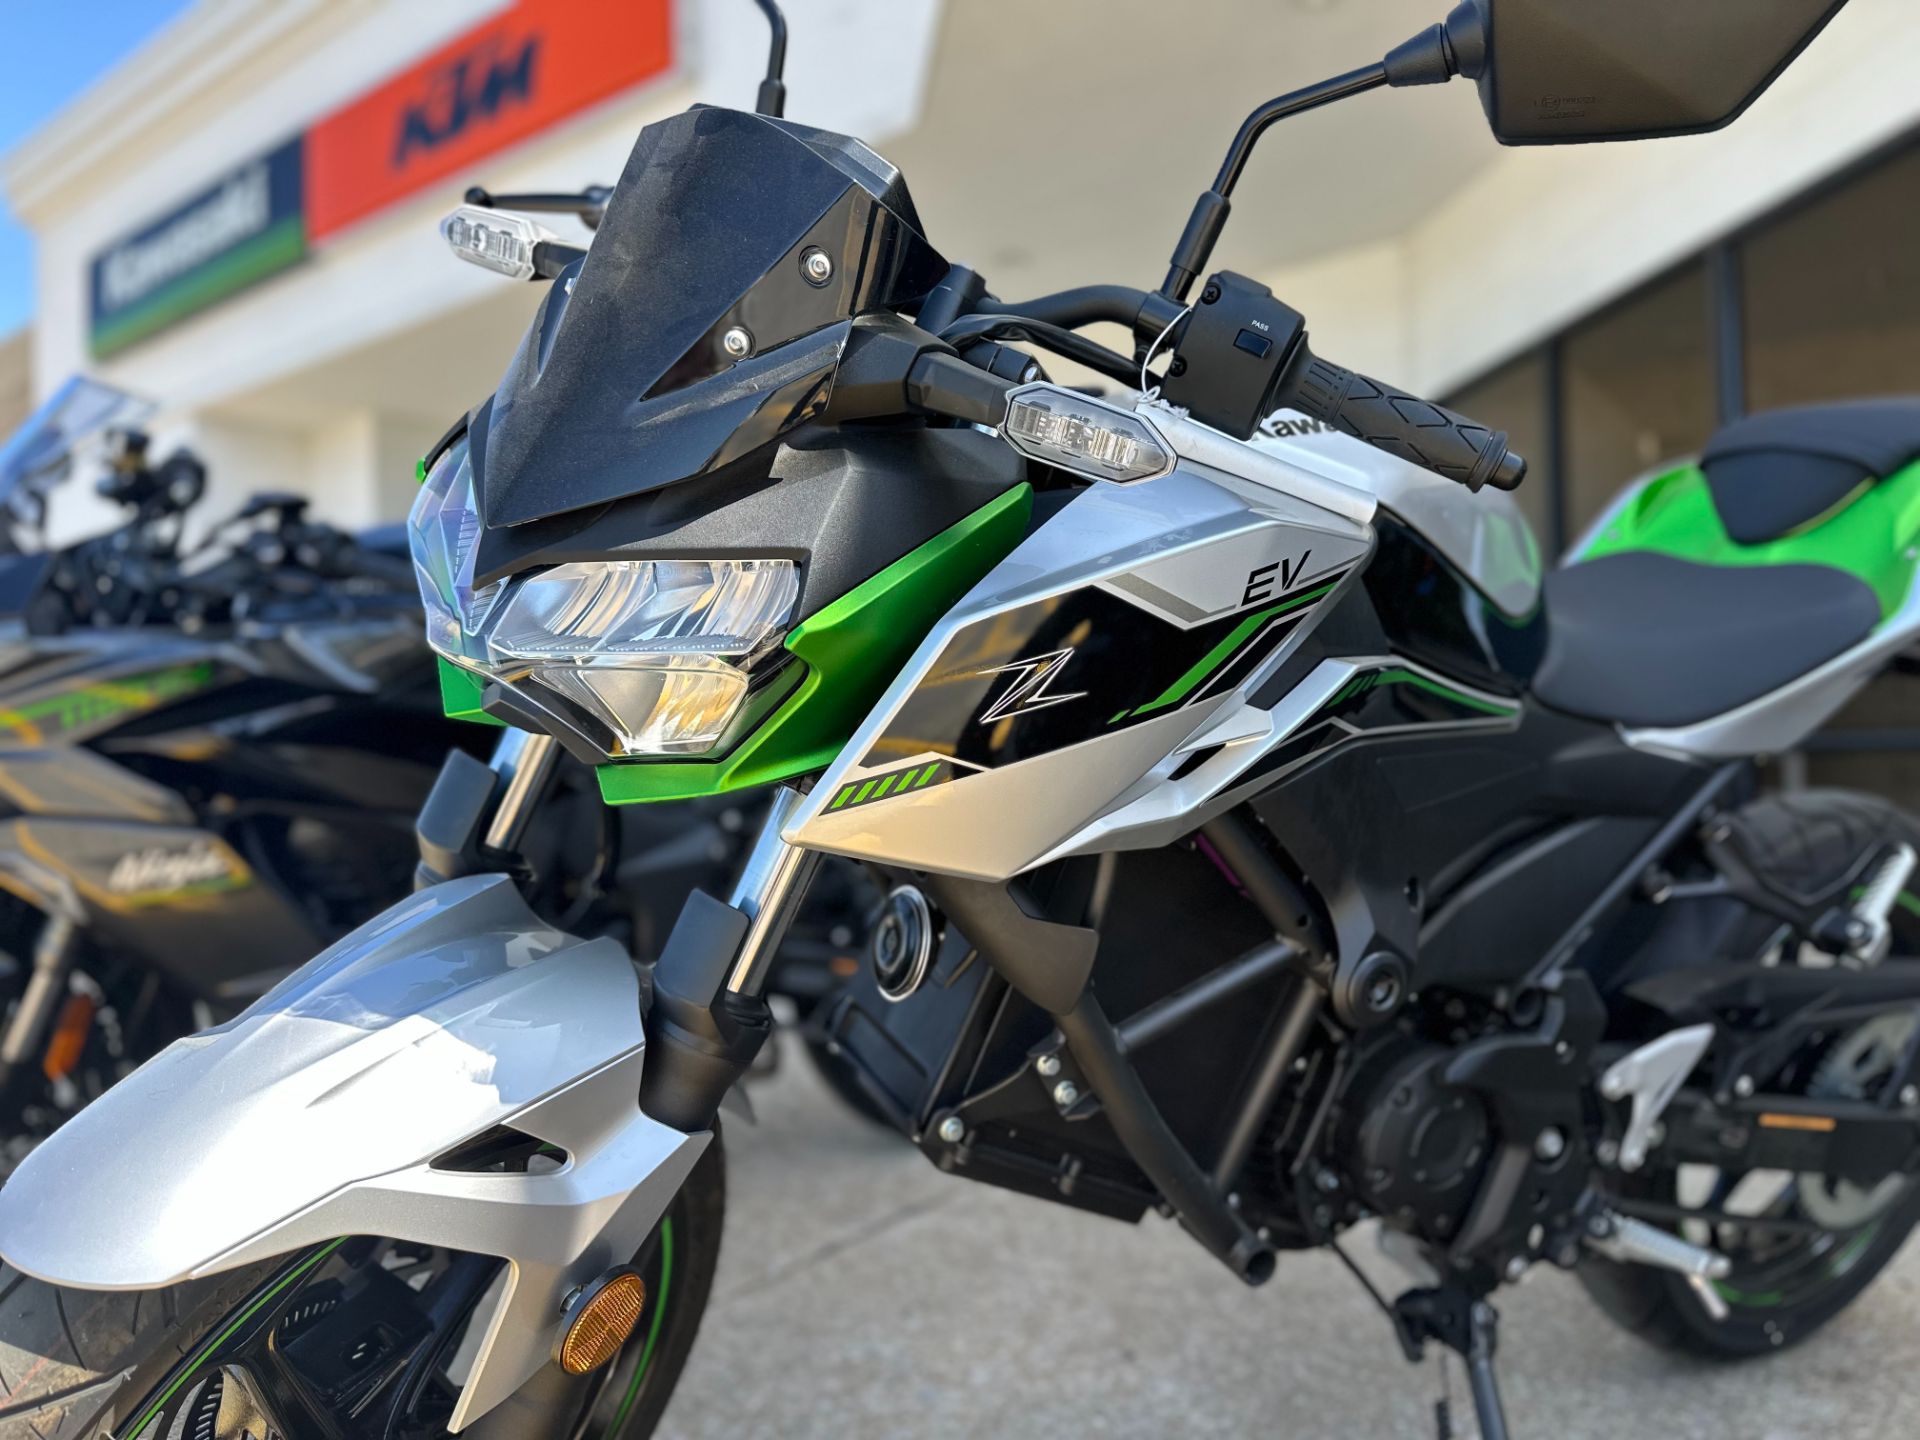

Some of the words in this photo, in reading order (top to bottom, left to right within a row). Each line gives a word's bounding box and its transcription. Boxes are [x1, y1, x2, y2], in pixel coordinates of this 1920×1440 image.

[392, 35, 542, 169] KTM
[1251, 319, 1270, 332] PASS
[1241, 551, 1311, 607] EV
[976, 647, 1089, 724] Z
